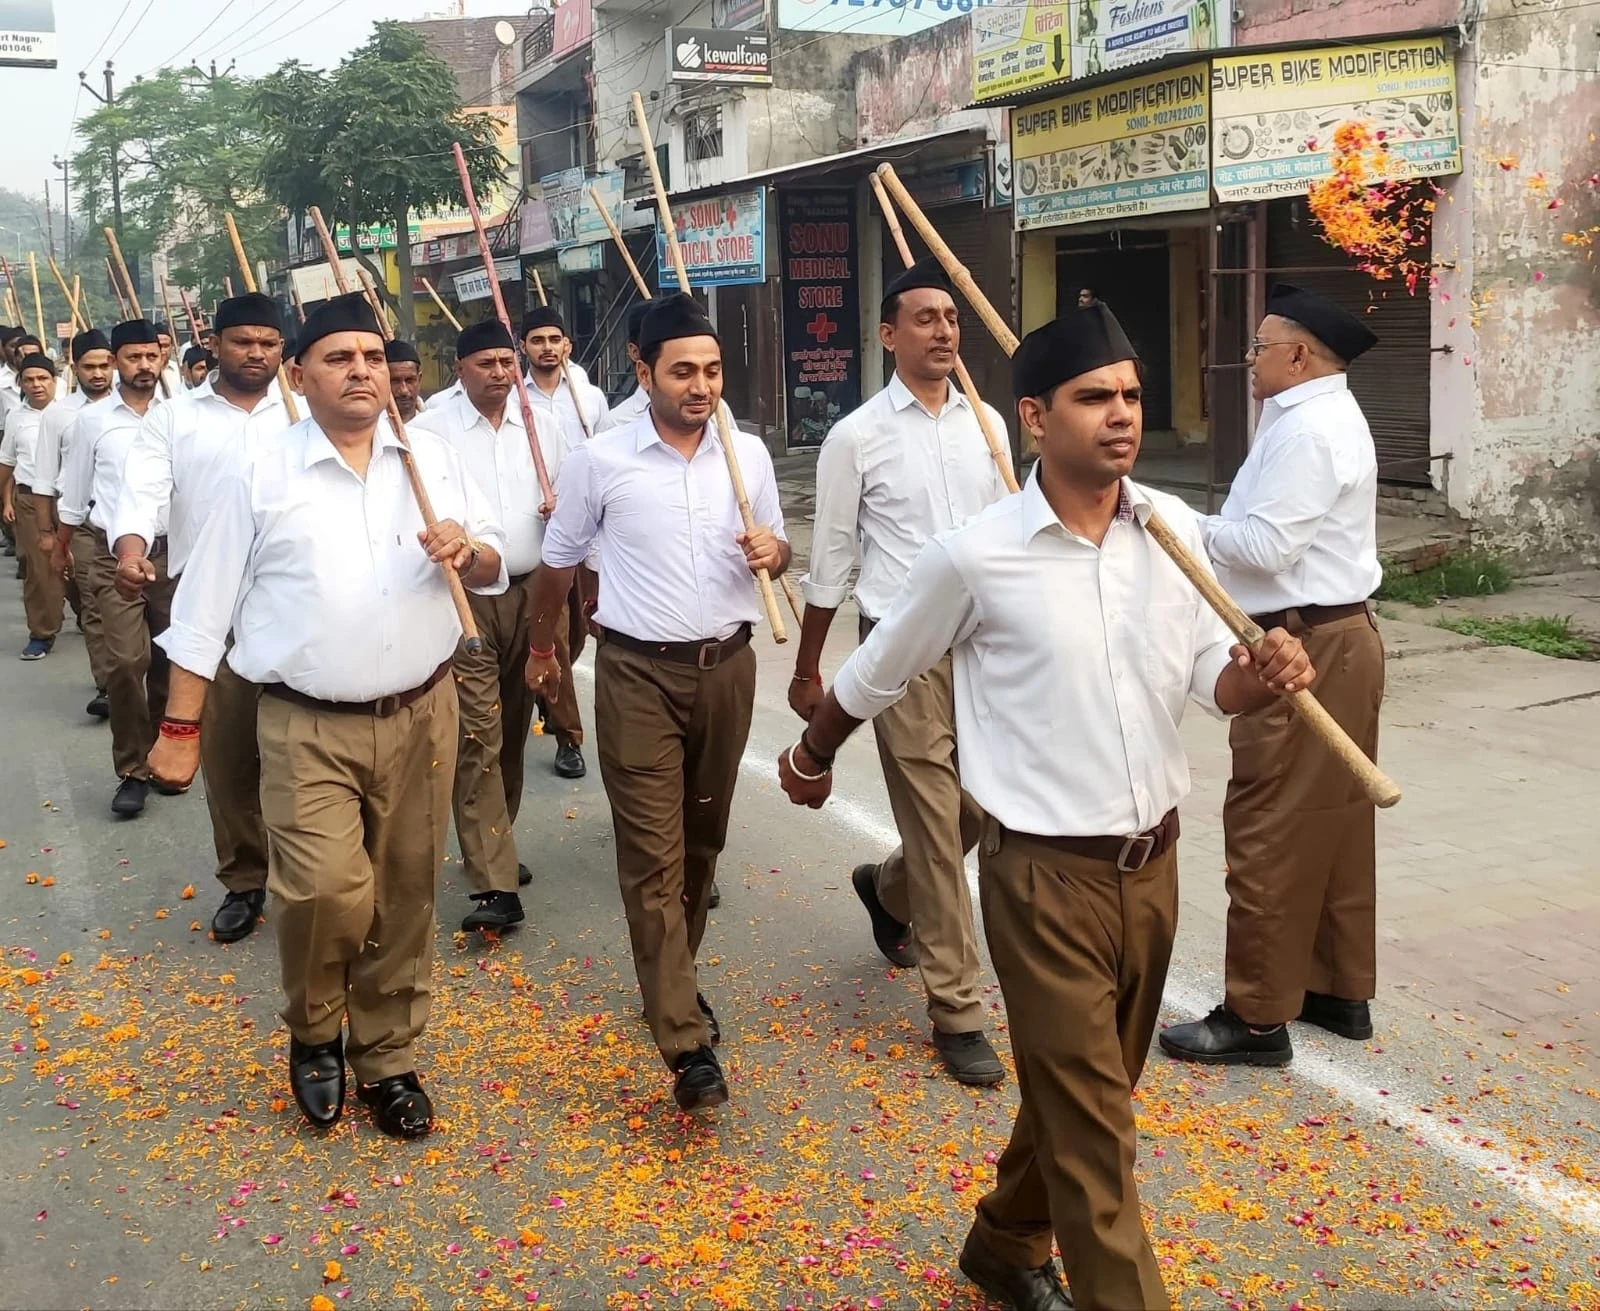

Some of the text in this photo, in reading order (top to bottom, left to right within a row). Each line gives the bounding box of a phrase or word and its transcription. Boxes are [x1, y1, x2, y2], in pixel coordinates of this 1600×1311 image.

[987, 8, 1022, 29] SHOBHIT
[1109, 0, 1165, 31] Fashions
[12, 35, 42, 44] Nagar,
[704, 43, 767, 65] kewalfone
[1212, 46, 1448, 91] SUPER BIKE MODIFICATION
[1017, 76, 1204, 136] SUPER BIKE MODIFICATION
[1153, 103, 1203, 125] 9027422070
[690, 202, 721, 230] SONU
[789, 222, 849, 253] SONU
[665, 235, 753, 268] MDICAL STORE
[789, 257, 851, 280] MEDICAL
[798, 286, 843, 308] STORE
